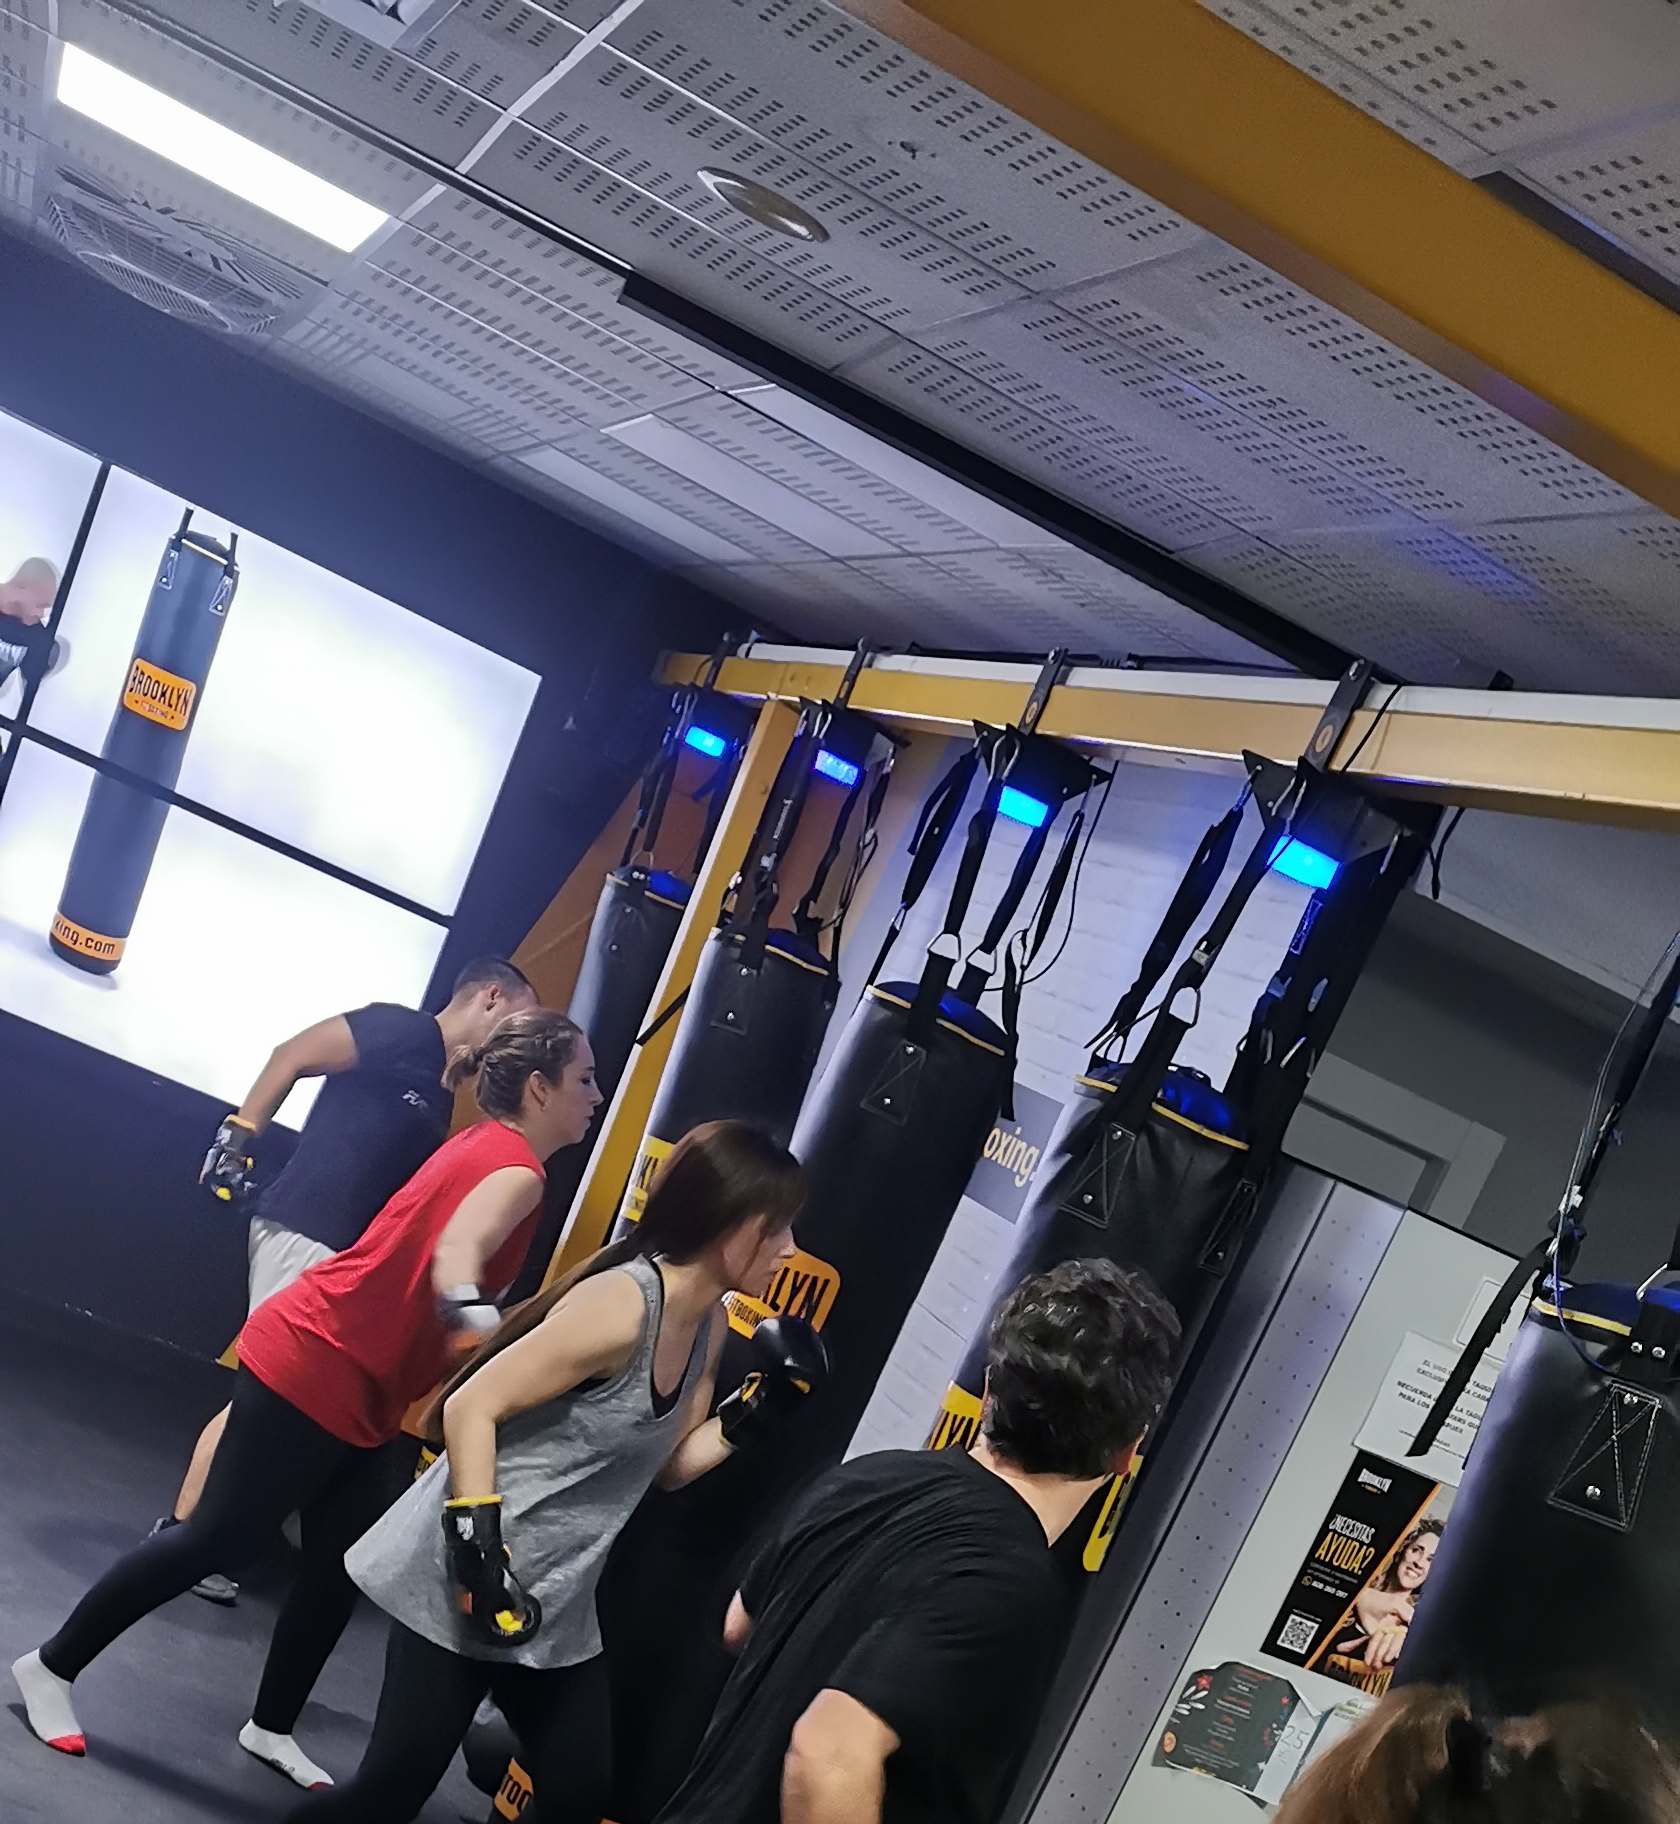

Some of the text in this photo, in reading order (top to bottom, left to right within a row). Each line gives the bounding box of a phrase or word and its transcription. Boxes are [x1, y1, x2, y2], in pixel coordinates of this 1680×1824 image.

[129, 665, 193, 716] BROOKLYN
[1314, 1531, 1376, 1576] AYUDA?
[1280, 1724, 1310, 1750] 25
